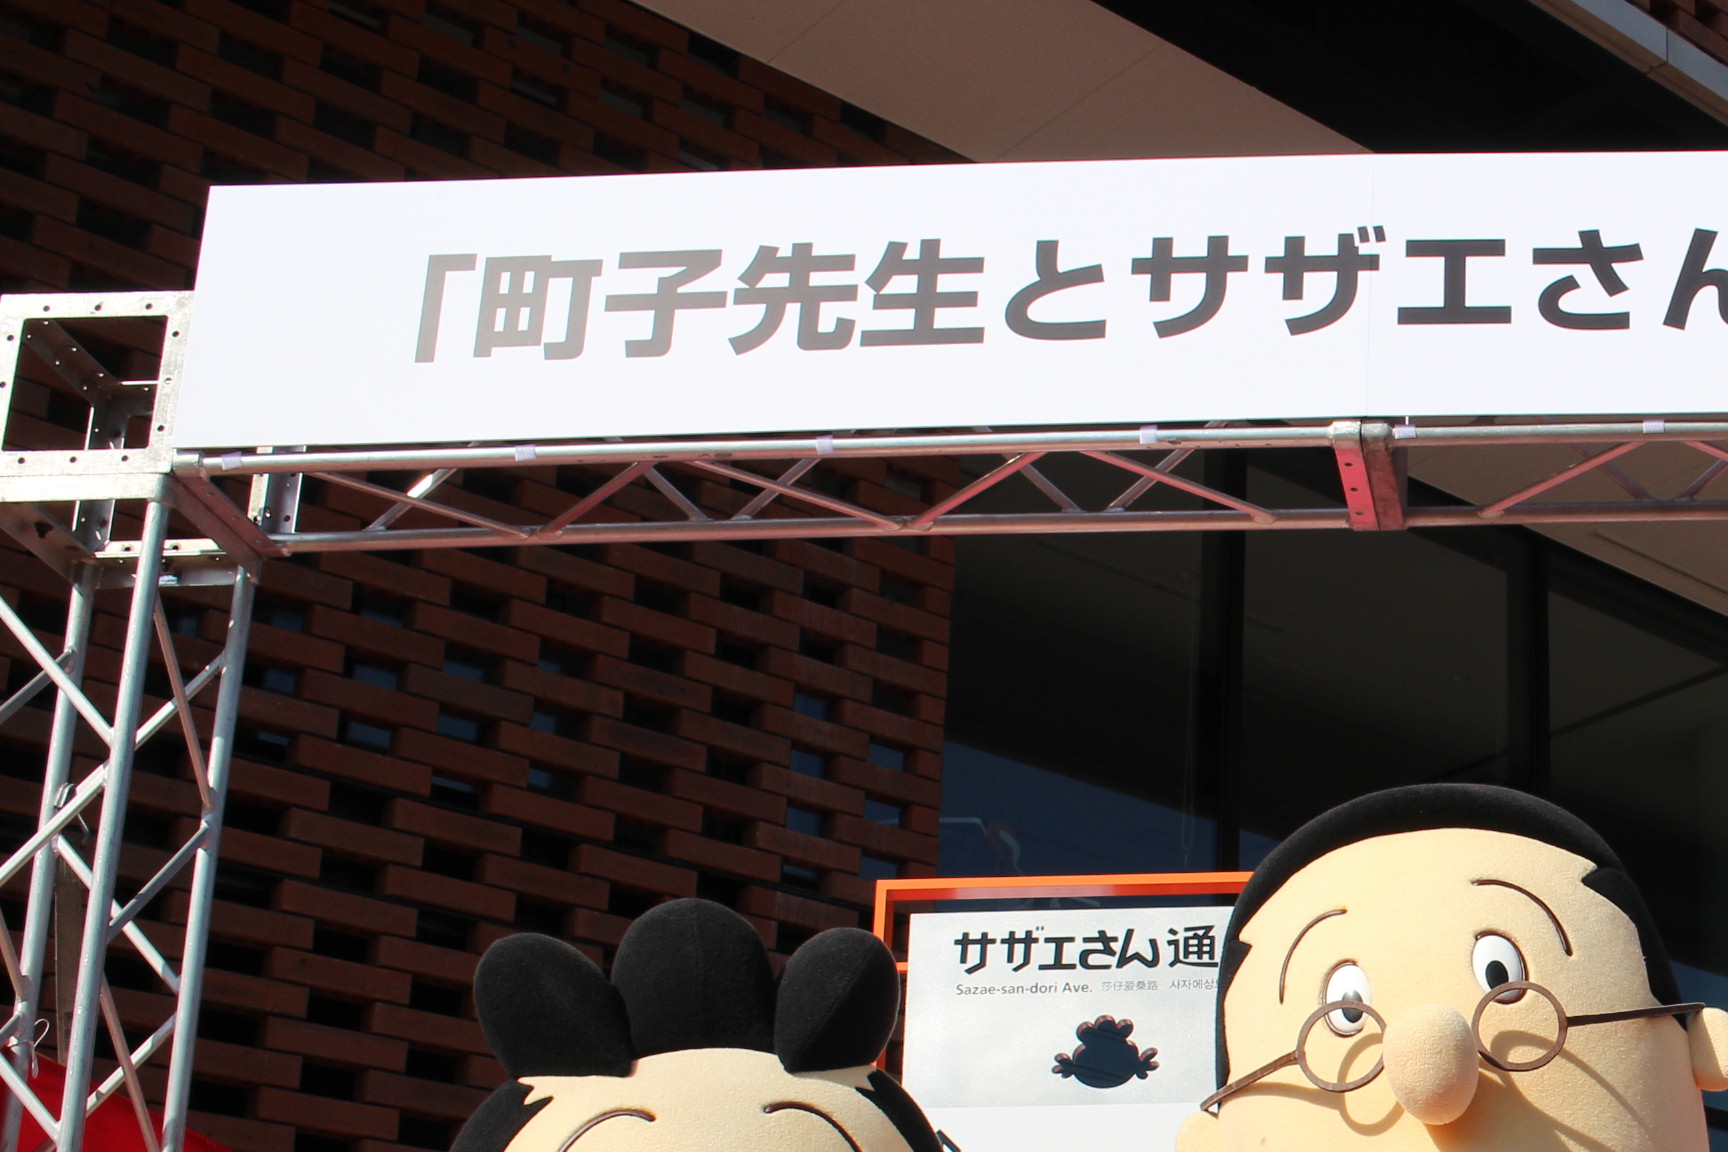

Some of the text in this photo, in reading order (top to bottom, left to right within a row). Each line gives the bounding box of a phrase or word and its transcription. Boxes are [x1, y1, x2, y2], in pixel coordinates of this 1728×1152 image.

[954, 925, 1219, 975] サザエさん通
[956, 982, 1094, 996] Sazae-san-dori Ave.
